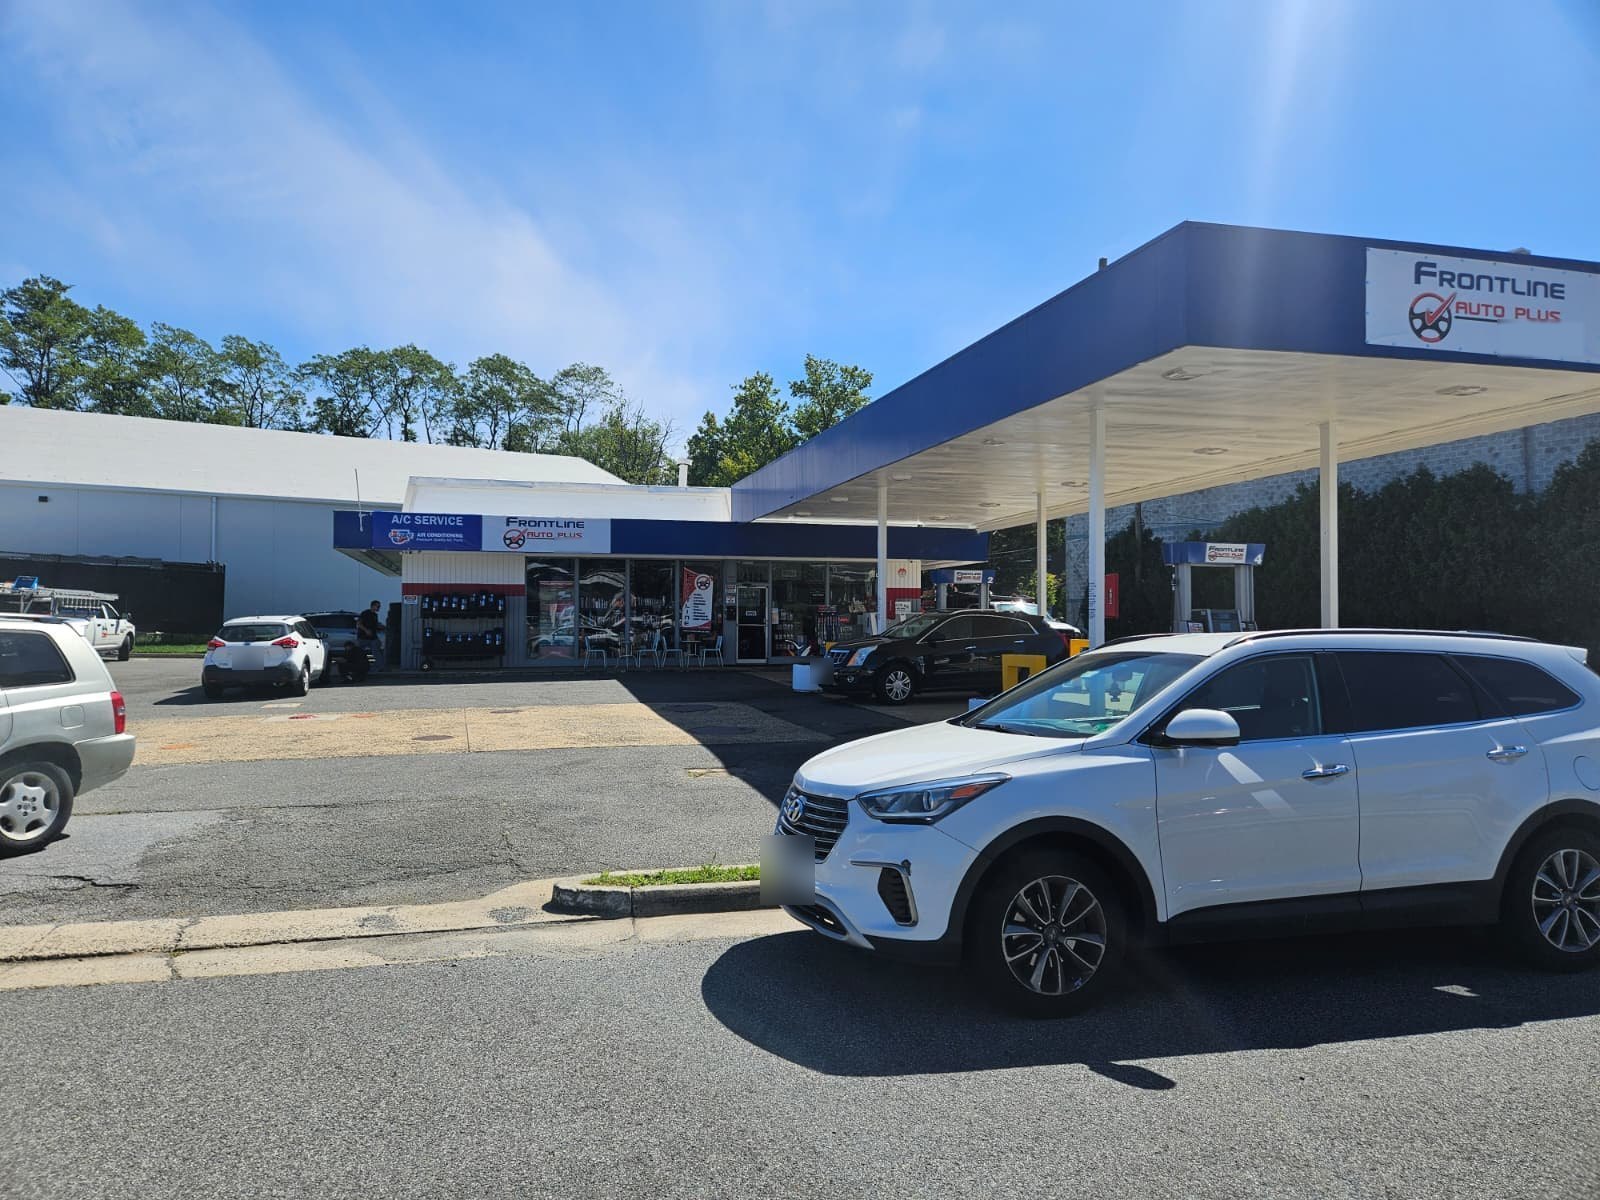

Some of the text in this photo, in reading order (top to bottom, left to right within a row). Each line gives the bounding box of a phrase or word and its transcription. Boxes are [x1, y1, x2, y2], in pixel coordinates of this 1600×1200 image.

[1414, 261, 1565, 300] FRONTLINE
[1455, 301, 1561, 322] AUTO PLUS
[391, 514, 464, 526] A/C SERVICE
[505, 516, 585, 529] FRONTLINE
[1254, 553, 1263, 565] 4
[987, 576, 994, 584] 2
